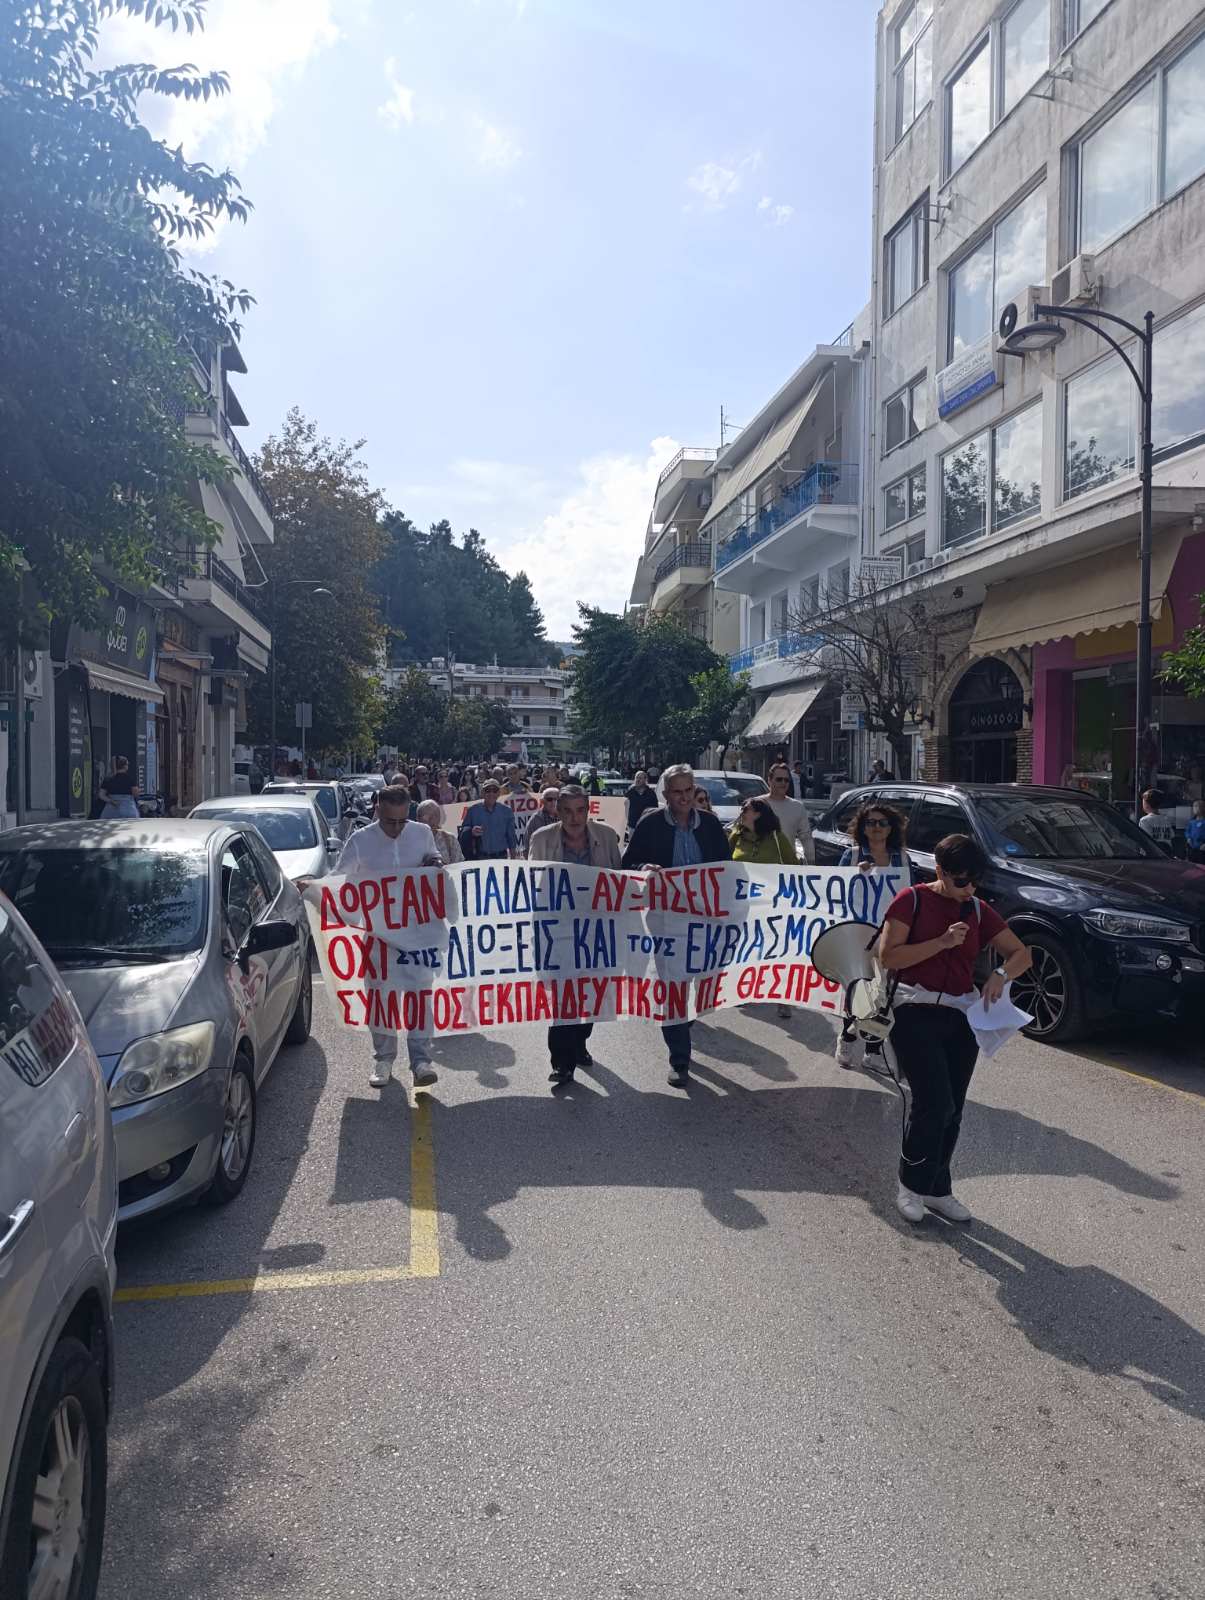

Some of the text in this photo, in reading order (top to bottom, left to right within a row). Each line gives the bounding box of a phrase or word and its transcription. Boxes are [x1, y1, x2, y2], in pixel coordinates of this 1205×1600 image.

[735, 878, 765, 901] ΣΕ
[327, 914, 836, 981] ΟΧΙ ΣΤΙΣ ΔΙΩΞΕΙΣ ΚΑΙ ΤΟΥΣ ΕΚΒΙΑΣΜΟ
[337, 987, 468, 1032] ΣΥΛΛΟΓΟΣ
[478, 976, 687, 1026] ΕΚΠΑΙΔΕΥΤΙΚΩΝ
